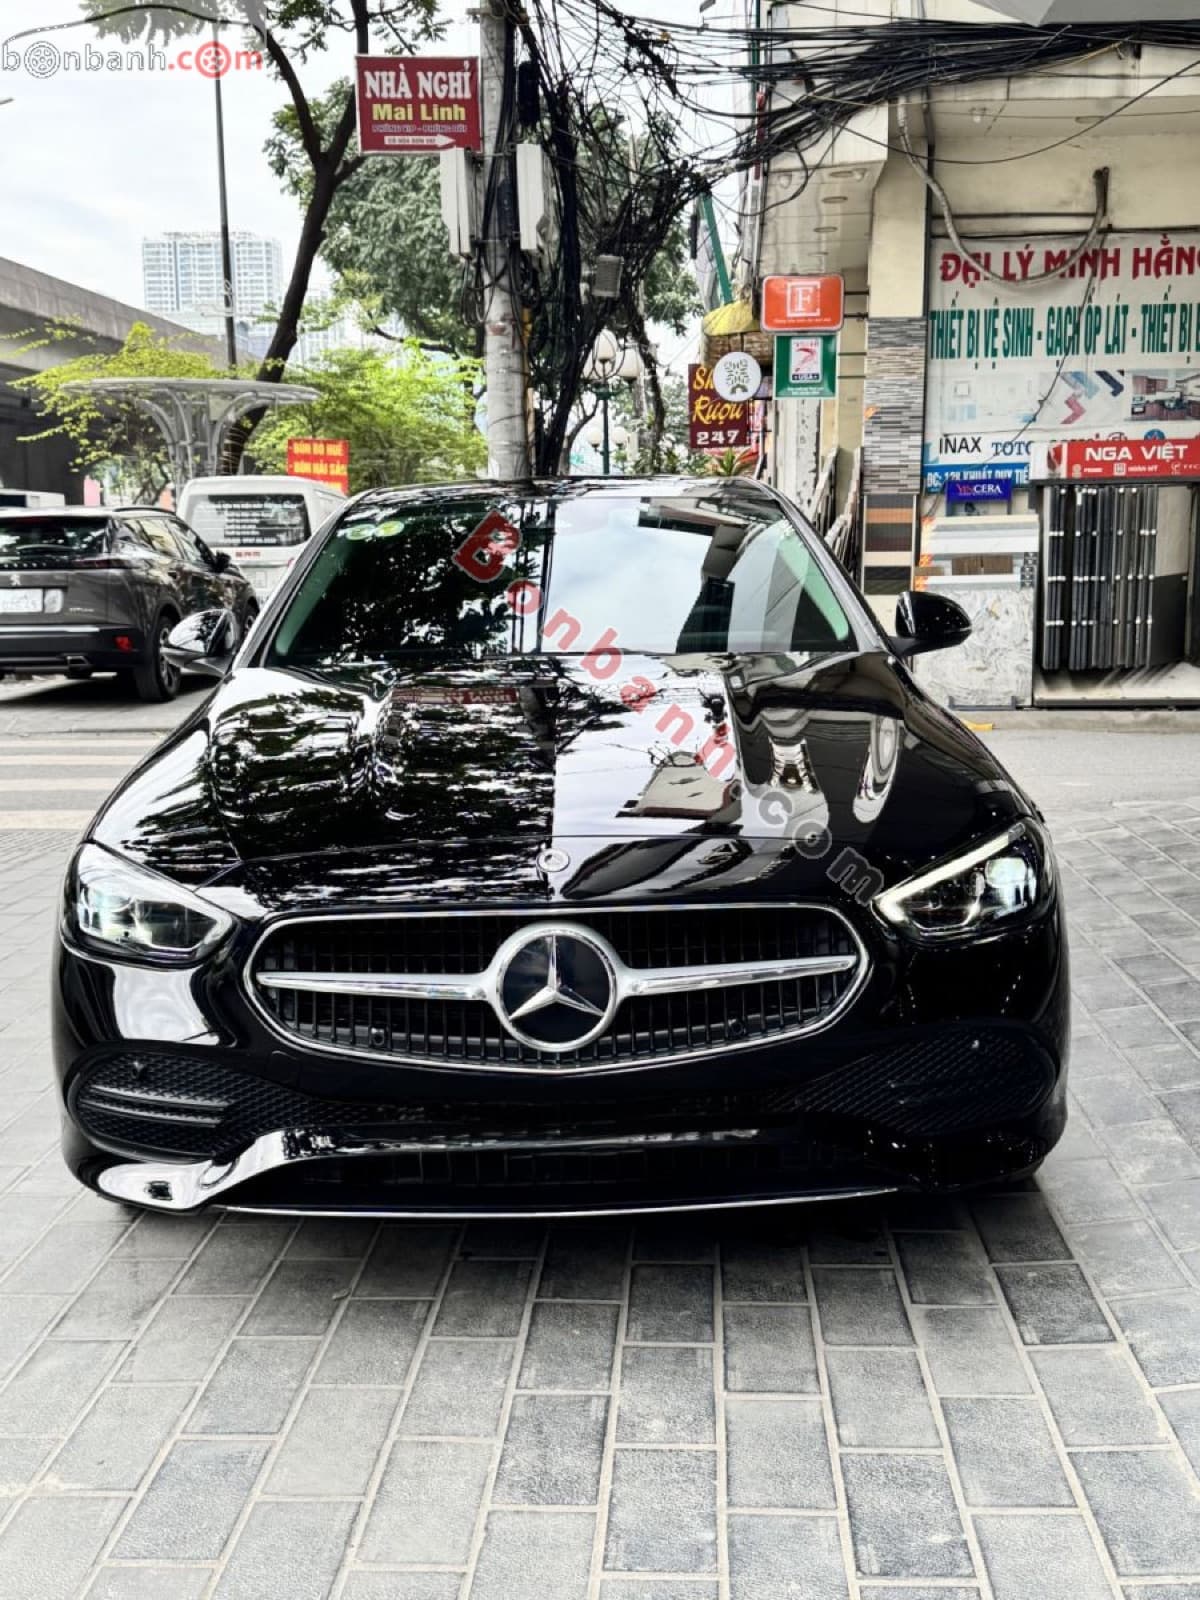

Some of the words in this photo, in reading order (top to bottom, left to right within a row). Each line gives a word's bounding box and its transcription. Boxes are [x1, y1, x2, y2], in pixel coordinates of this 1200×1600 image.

[364, 63, 412, 99] NHÀ
[417, 60, 471, 99] NGHỈ
[372, 103, 413, 121] Mai
[420, 103, 466, 121] Linh
[940, 252, 991, 288] ĐẠI
[1003, 244, 1034, 282] LÝ
[1045, 248, 1121, 281] MINH
[1132, 233, 1200, 280] HẰN
[929, 290, 964, 360] THIẾT
[967, 309, 980, 369] BỊ
[984, 297, 999, 369] VỆ
[1003, 307, 1034, 358] SINH
[1047, 303, 1081, 367] GẠCH
[1104, 293, 1129, 355] LÁT
[1141, 284, 1177, 354] THIẾT
[1178, 303, 1193, 364] BỊ
[696, 430, 740, 445] 247
[939, 436, 982, 454] INAX
[1085, 445, 1134, 462] NGA
[1141, 441, 1188, 465] VIỆT
